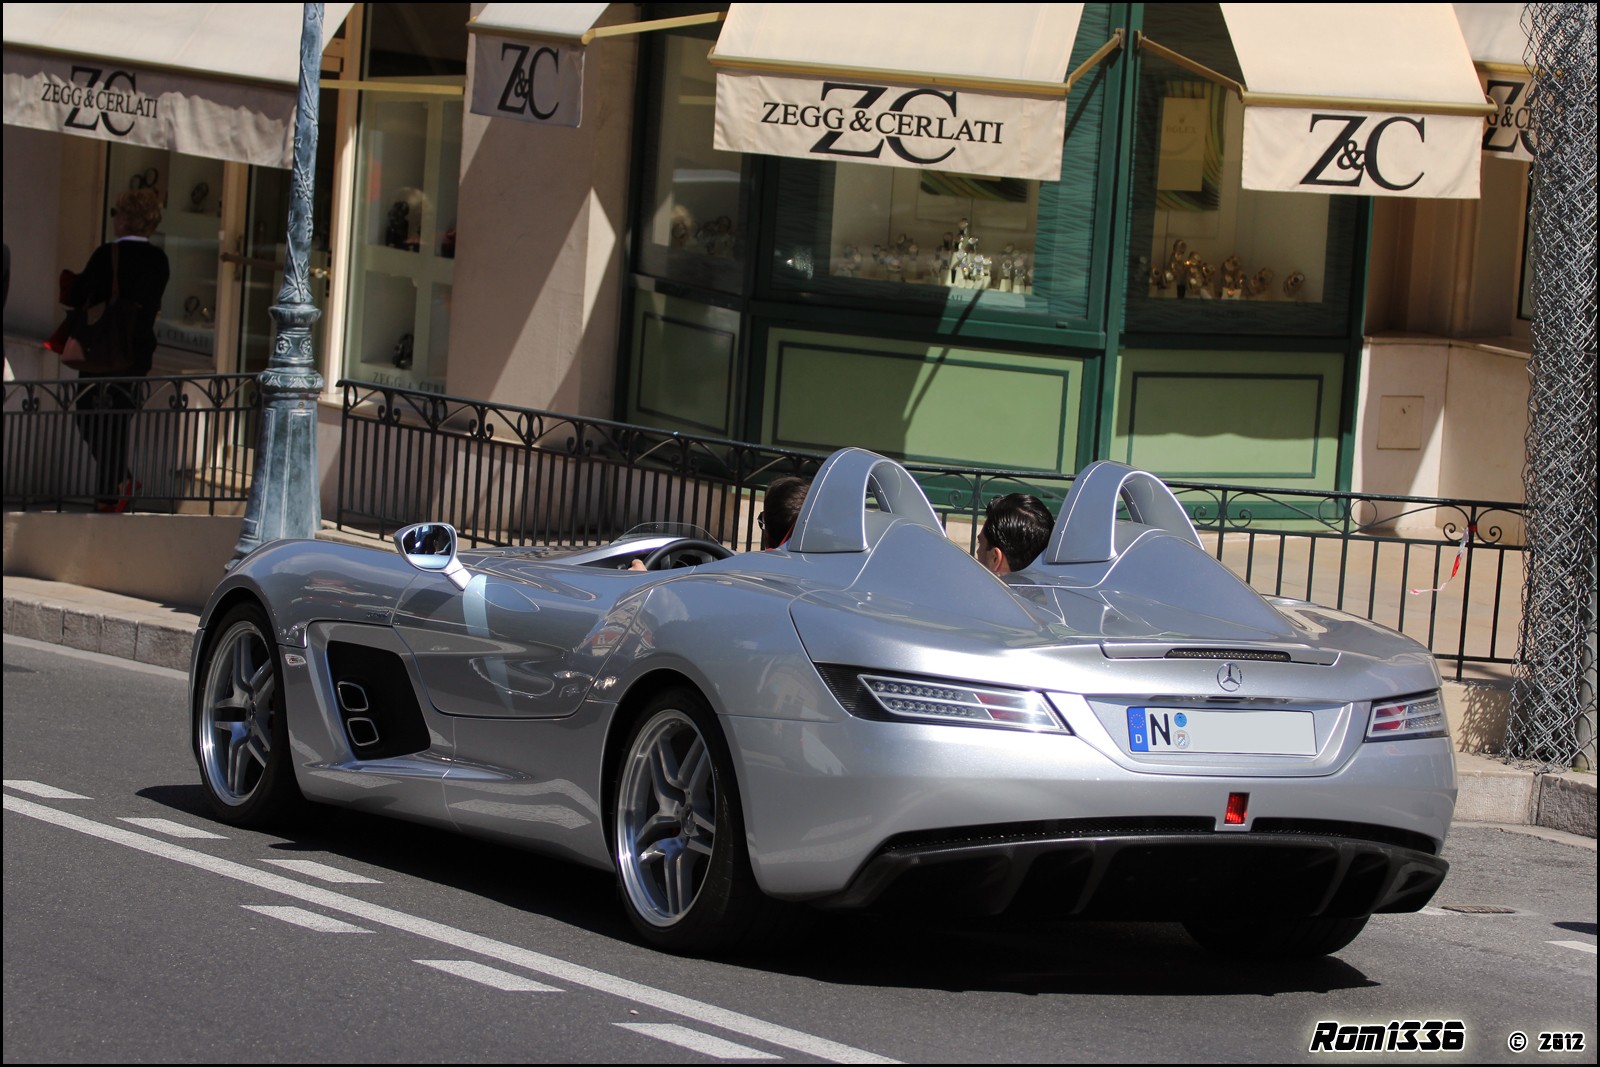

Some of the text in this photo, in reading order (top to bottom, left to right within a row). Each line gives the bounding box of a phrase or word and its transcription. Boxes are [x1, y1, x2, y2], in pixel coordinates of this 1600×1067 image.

[761, 102, 844, 130] ZEGG
[876, 112, 1004, 144] CERLATI
[1299, 114, 1424, 191] Z&C
[1135, 734, 1143, 744] D
[1149, 713, 1171, 746] N
